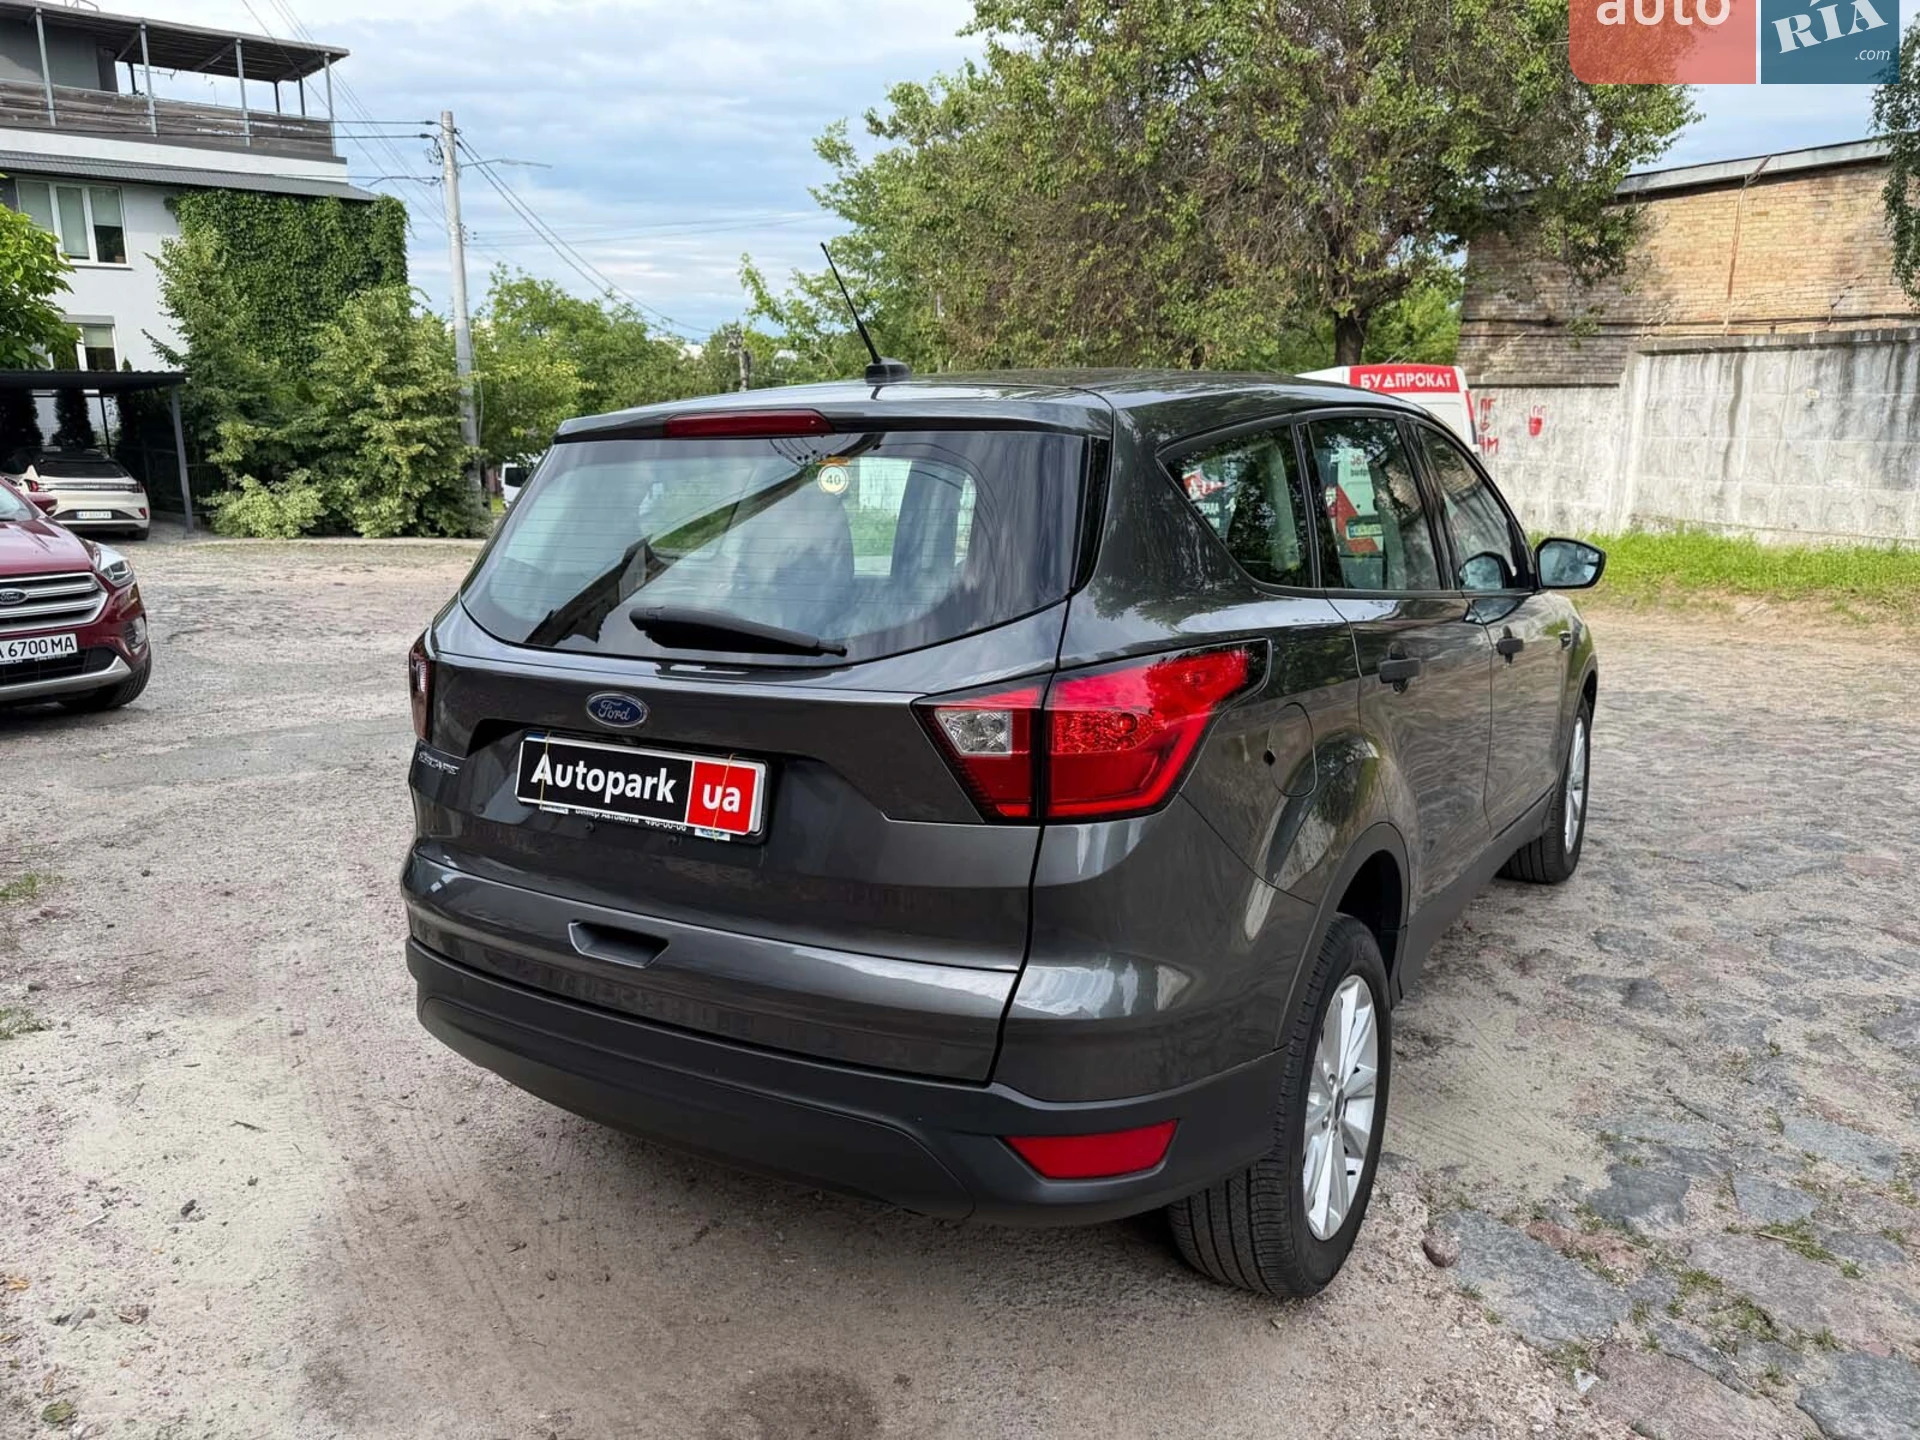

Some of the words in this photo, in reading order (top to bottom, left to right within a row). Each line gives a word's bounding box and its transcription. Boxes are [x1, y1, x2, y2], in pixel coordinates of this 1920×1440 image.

[1360, 372, 1450, 389] БУДПРОКАТ
[826, 474, 841, 484] 40
[8, 639, 48, 657] 6700
[50, 636, 75, 653] MA
[598, 700, 630, 720] Ford
[530, 752, 677, 804] Autopark
[702, 783, 741, 813] ua
